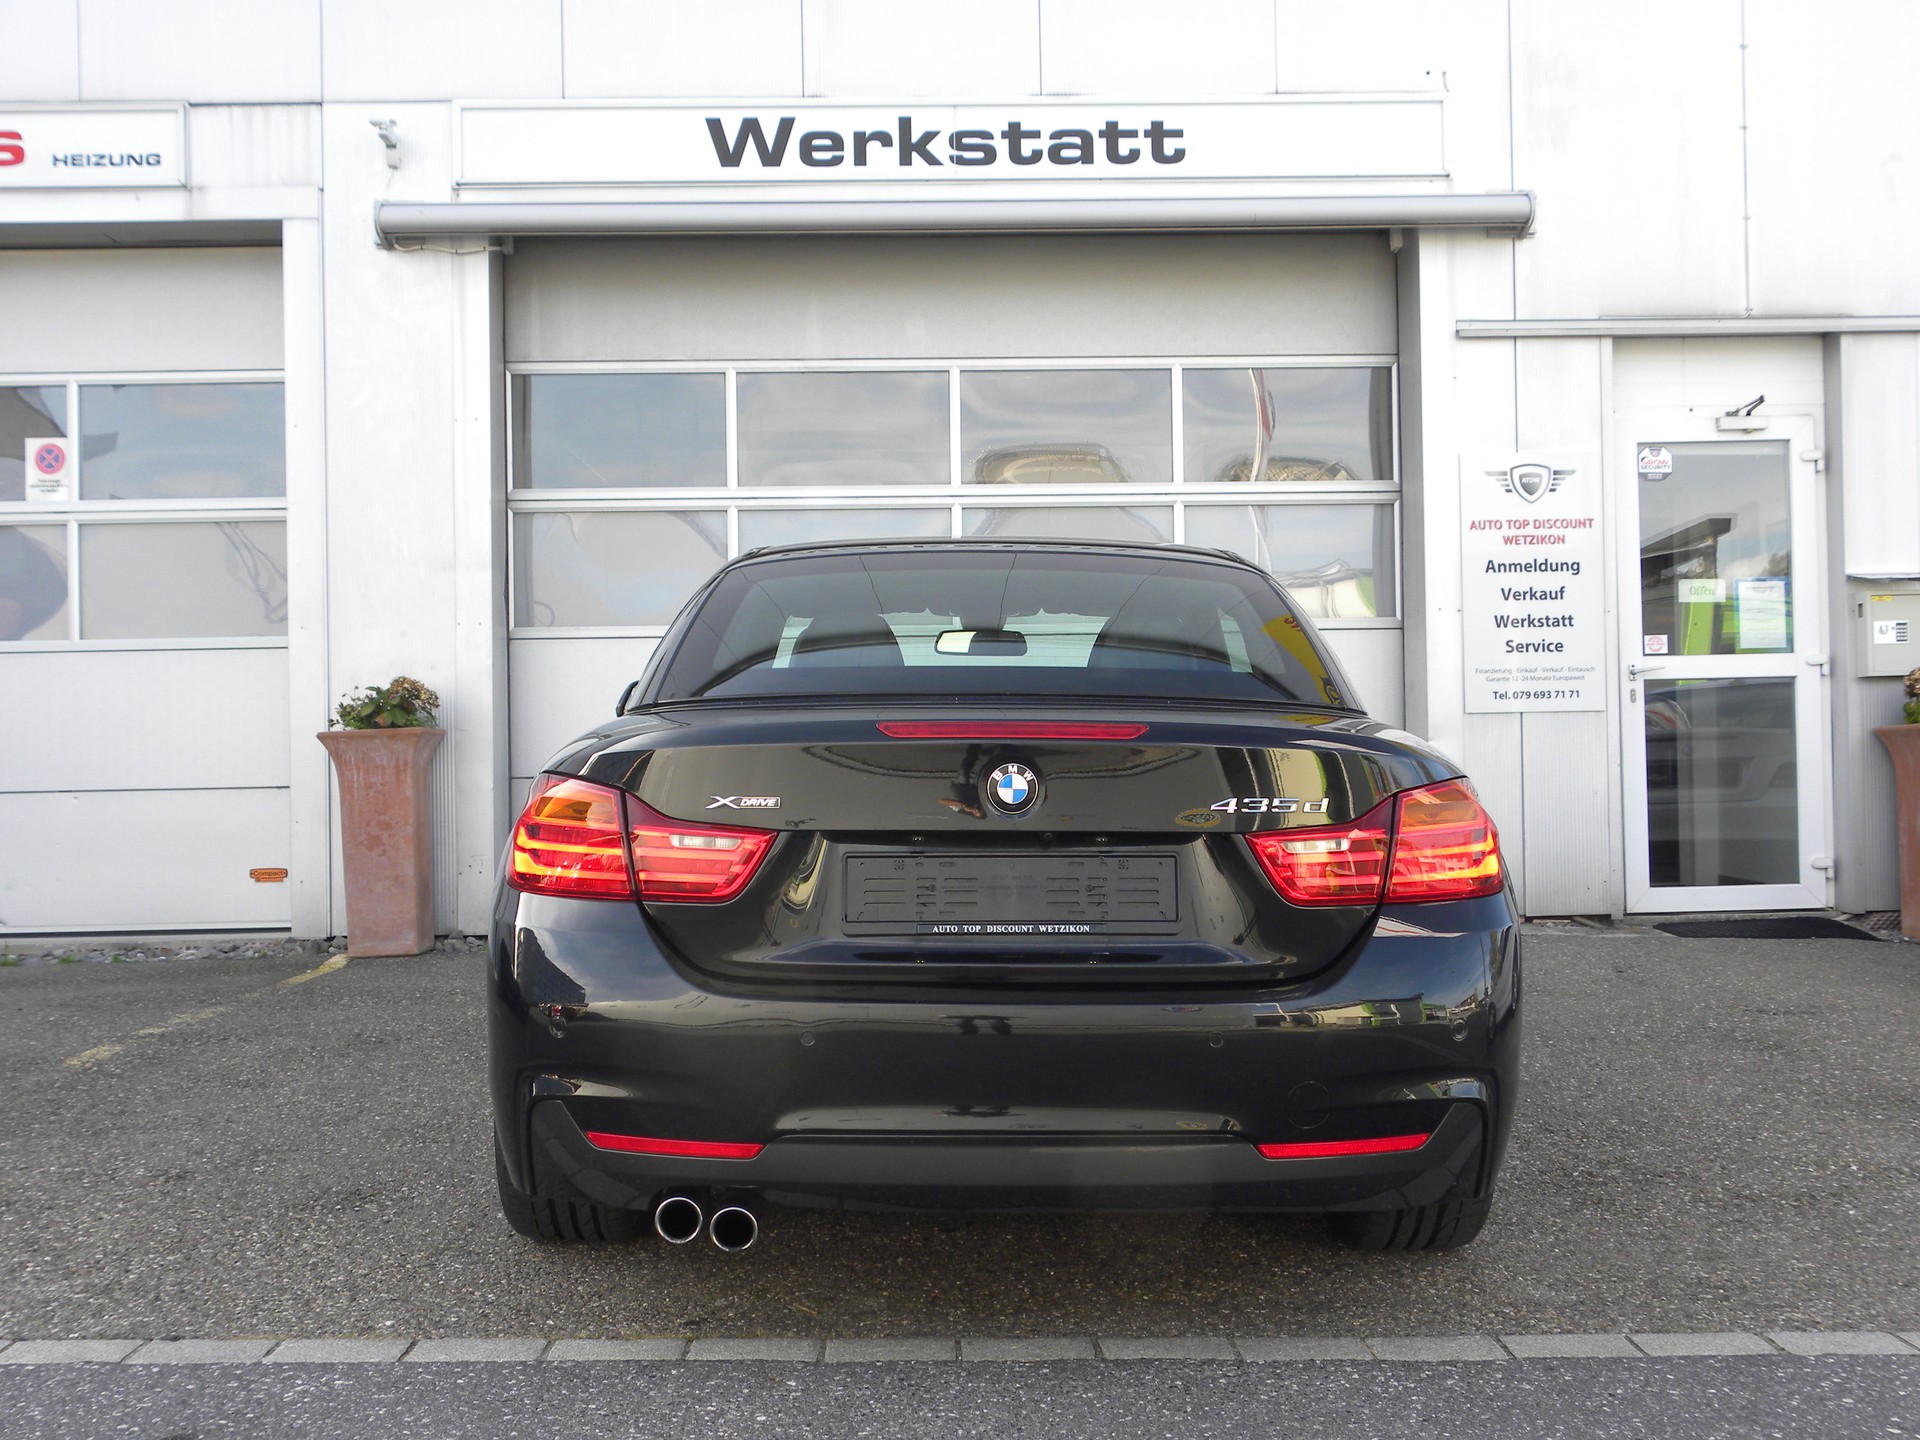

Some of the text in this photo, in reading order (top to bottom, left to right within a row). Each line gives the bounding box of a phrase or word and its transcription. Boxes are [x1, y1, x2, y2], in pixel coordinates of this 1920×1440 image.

[705, 116, 1186, 168] Werkstatt
[52, 153, 161, 167] HEIZUNG
[1469, 518, 1594, 531] AUTO TOP DISCOUNT
[1502, 534, 1566, 546] WETZIKON
[1485, 558, 1581, 576] Anmeldung
[1500, 586, 1566, 601] Verkauf
[1689, 585, 1715, 596] Offen
[1494, 613, 1574, 629] Werkstatt
[1505, 639, 1564, 653] Service
[1492, 690, 1580, 700] Tel. 079 693 71 71
[992, 765, 1034, 782] BMW
[1210, 797, 1330, 814] 435d
[932, 924, 1090, 933] AUTO TOP DISCOUNT WETZIKON
